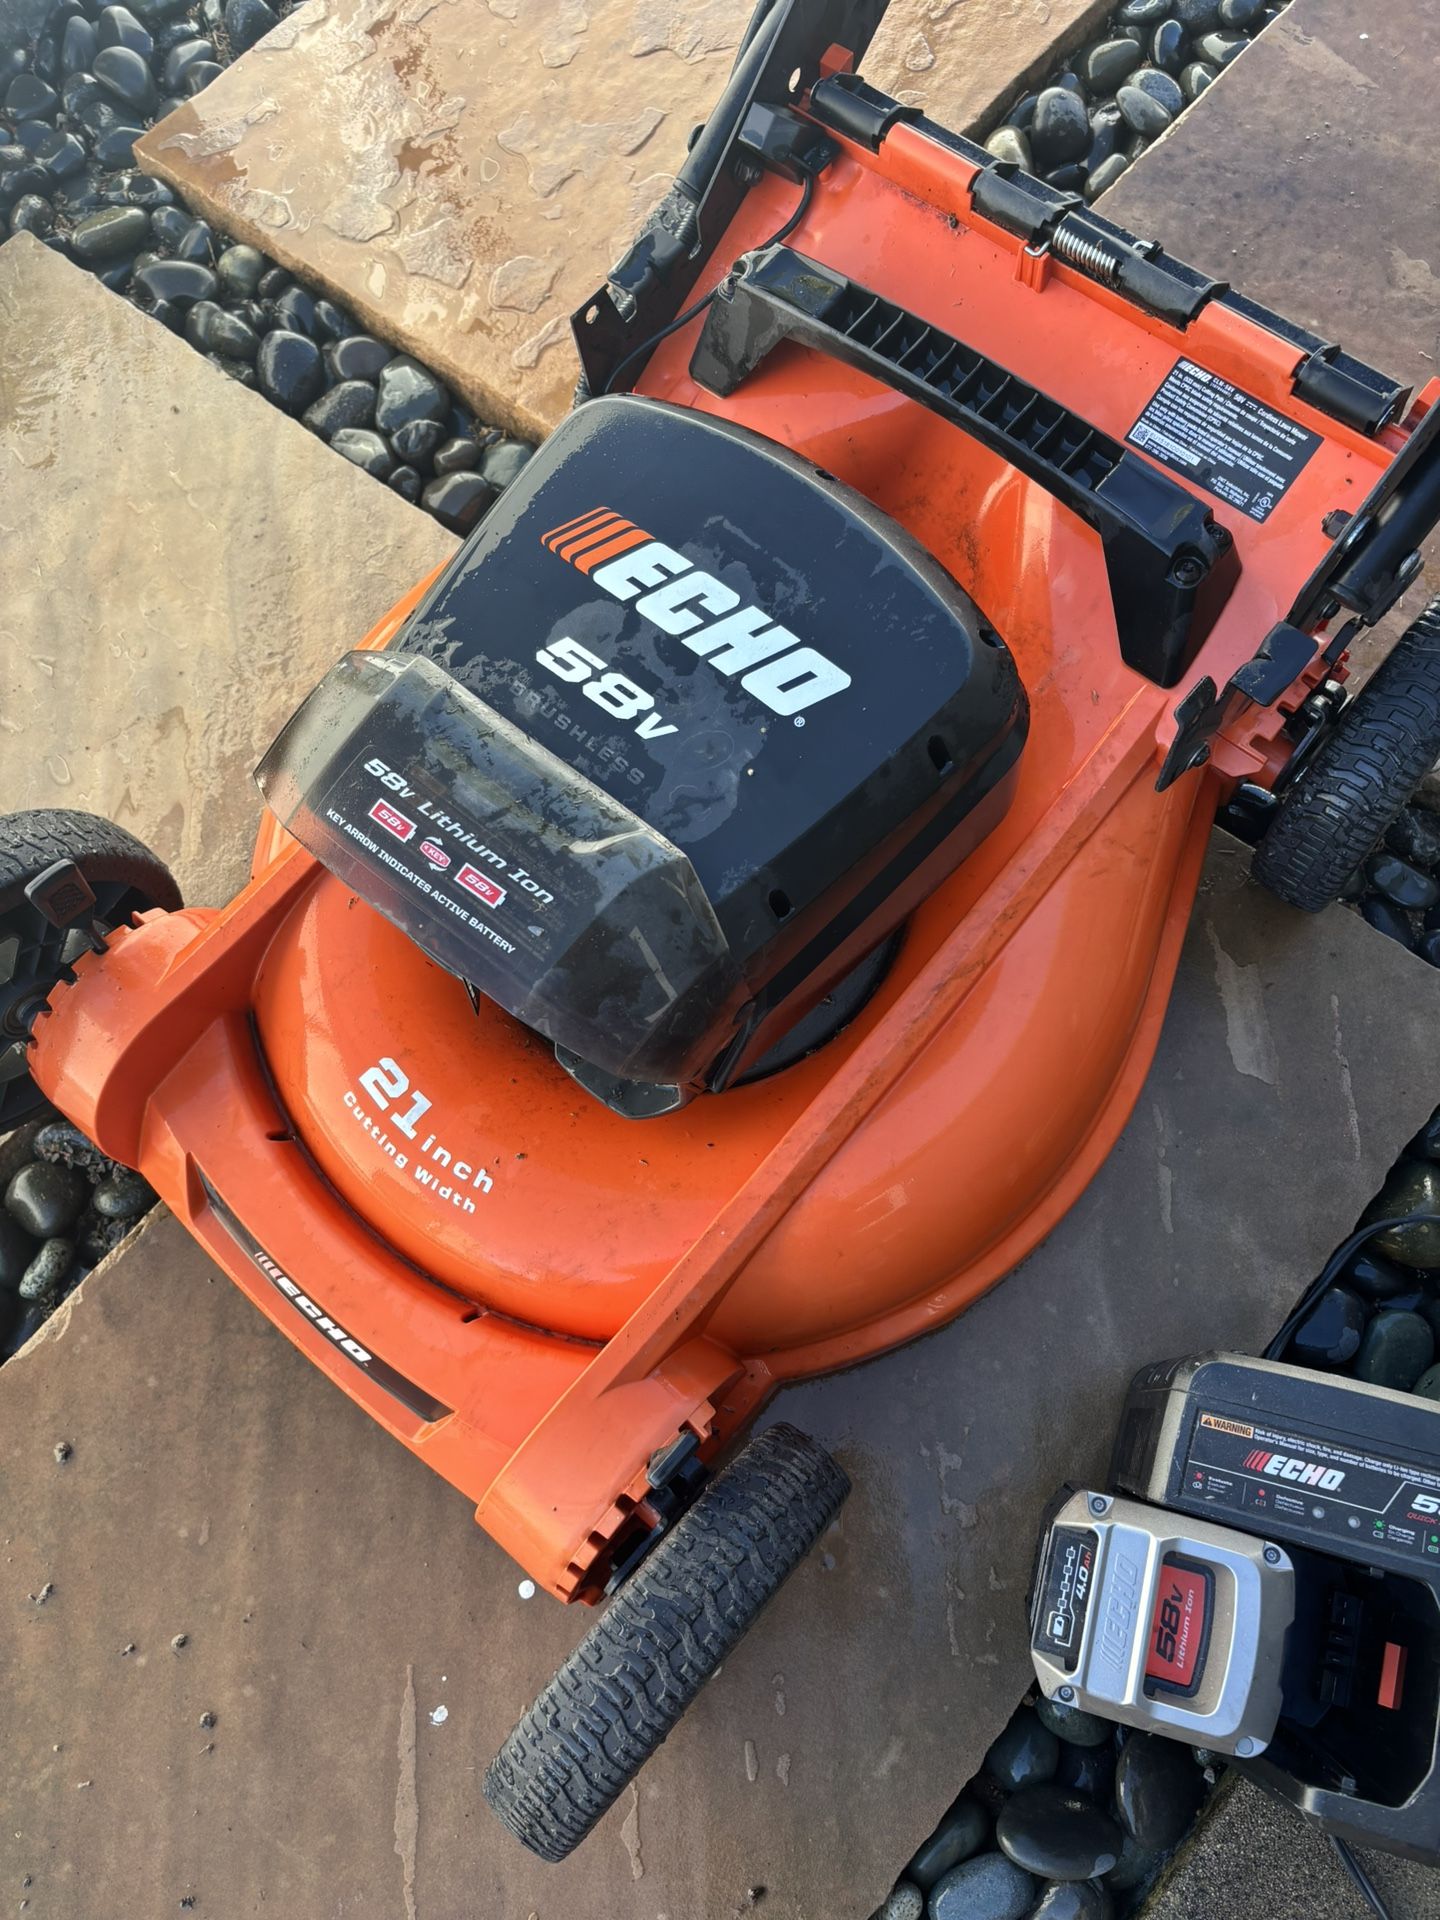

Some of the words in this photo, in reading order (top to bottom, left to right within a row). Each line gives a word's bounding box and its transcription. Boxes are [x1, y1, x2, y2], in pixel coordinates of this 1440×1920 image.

[1183, 362, 1212, 384] ECHO
[1256, 407, 1280, 424] Cordless
[1276, 419, 1292, 432] Lawn
[1289, 426, 1309, 441] Mower
[593, 542, 851, 716] ECHO
[416, 800, 508, 870] Lithium
[507, 868, 554, 904] Ion
[427, 846, 446, 863] KEY
[325, 808, 344, 827] KEY
[343, 820, 381, 853] ARROW
[377, 849, 432, 893] INDICATES
[430, 889, 469, 921] ACTIVE
[468, 912, 517, 955] BATTERY
[343, 1090, 409, 1169] Cutting
[414, 1165, 476, 1214] Width
[358, 1057, 433, 1140] 21
[421, 1133, 494, 1194] inch
[277, 1276, 372, 1362] ECHO
[1212, 1419, 1251, 1436] WARNING
[1254, 1428, 1265, 1436] Risk
[1264, 1455, 1345, 1491] ECHO
[1407, 1511, 1438, 1525] QUICK
[1411, 1493, 1440, 1514] 5
[1103, 1552, 1138, 1650] ECHO
[1176, 1617, 1190, 1669] Lithium
[1185, 1588, 1195, 1613] Ion
